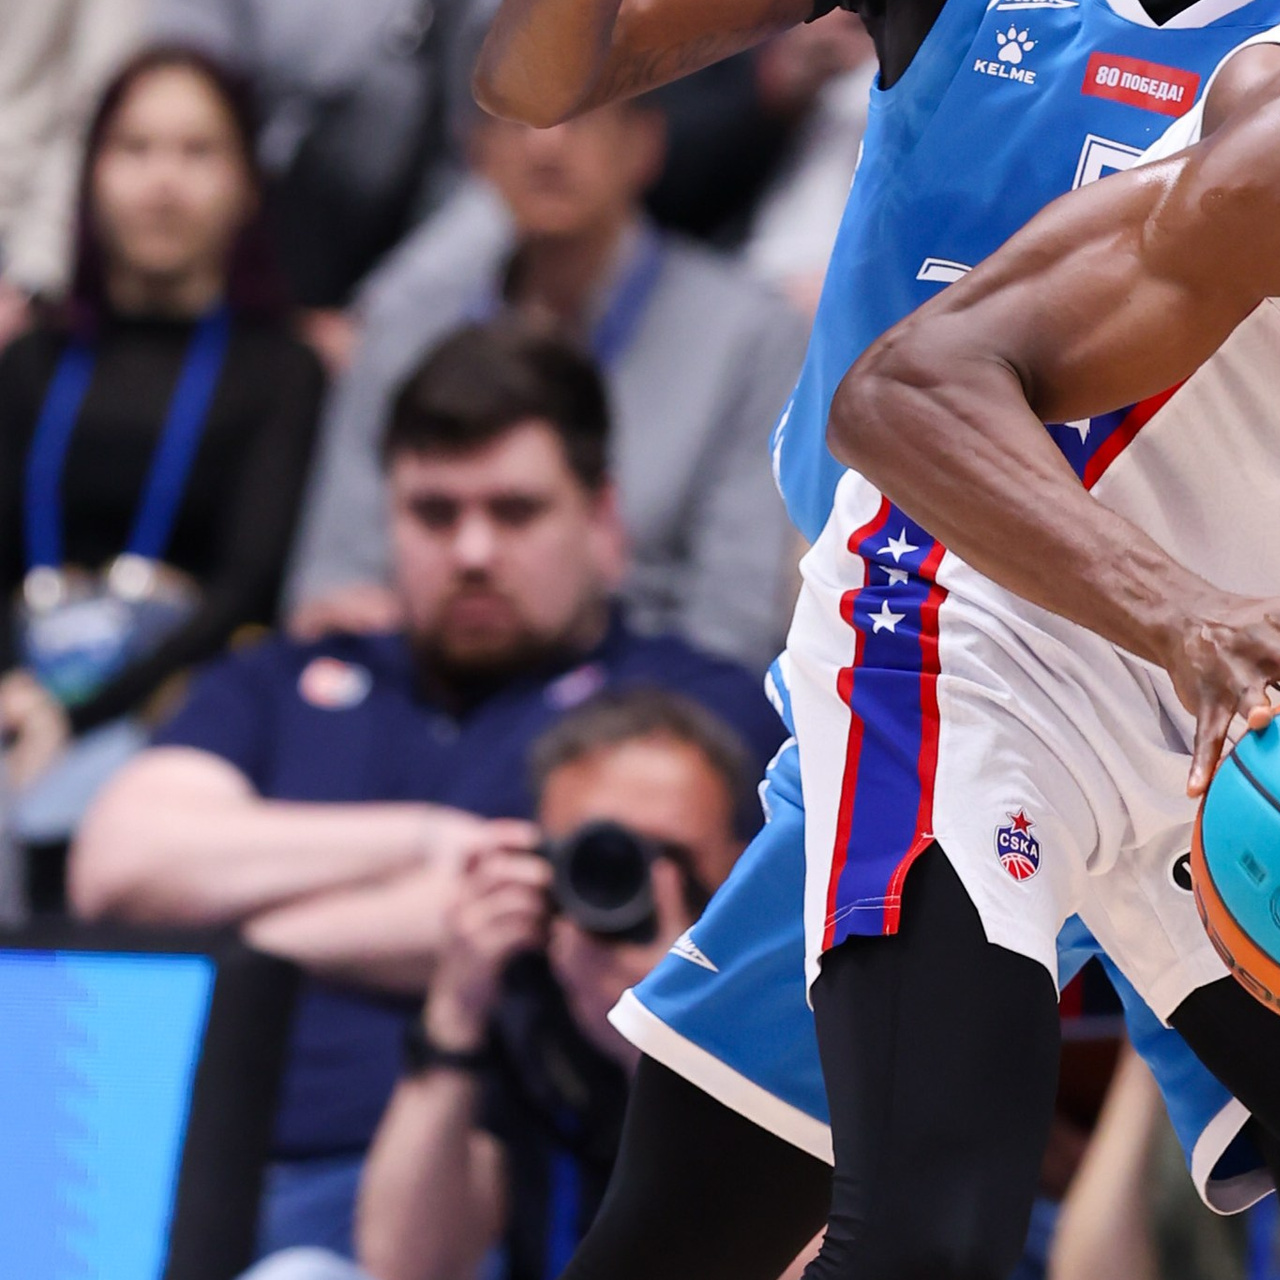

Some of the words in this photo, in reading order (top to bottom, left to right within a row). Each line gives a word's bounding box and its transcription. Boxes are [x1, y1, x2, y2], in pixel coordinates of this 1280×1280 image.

[973, 59, 1037, 85] KELME
[1095, 65, 1121, 88] 80
[1120, 71, 1185, 103] ПОБЕДА!
[999, 832, 1039, 859] CSKA
